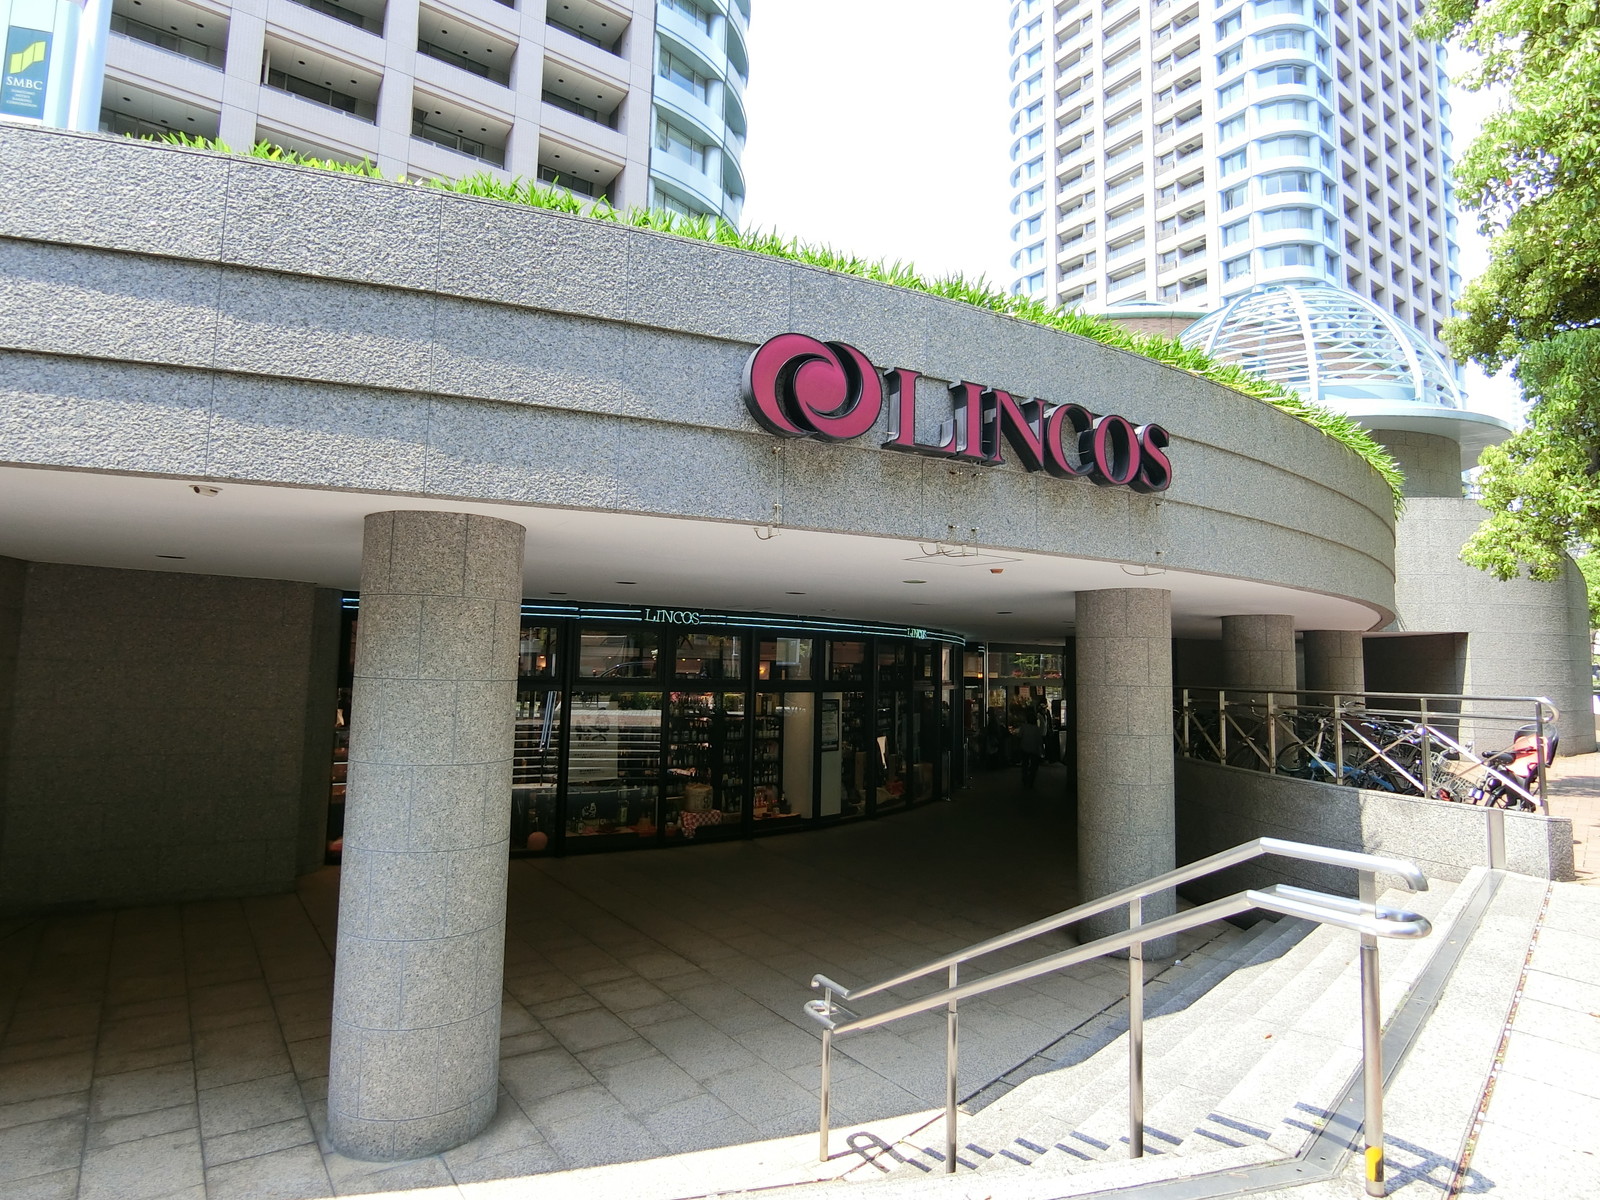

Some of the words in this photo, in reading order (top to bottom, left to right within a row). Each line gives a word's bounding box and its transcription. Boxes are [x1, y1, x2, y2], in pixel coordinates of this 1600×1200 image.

[6, 76, 43, 91] SMBC
[881, 367, 1173, 495] LINCOS
[644, 608, 700, 625] LINCOS
